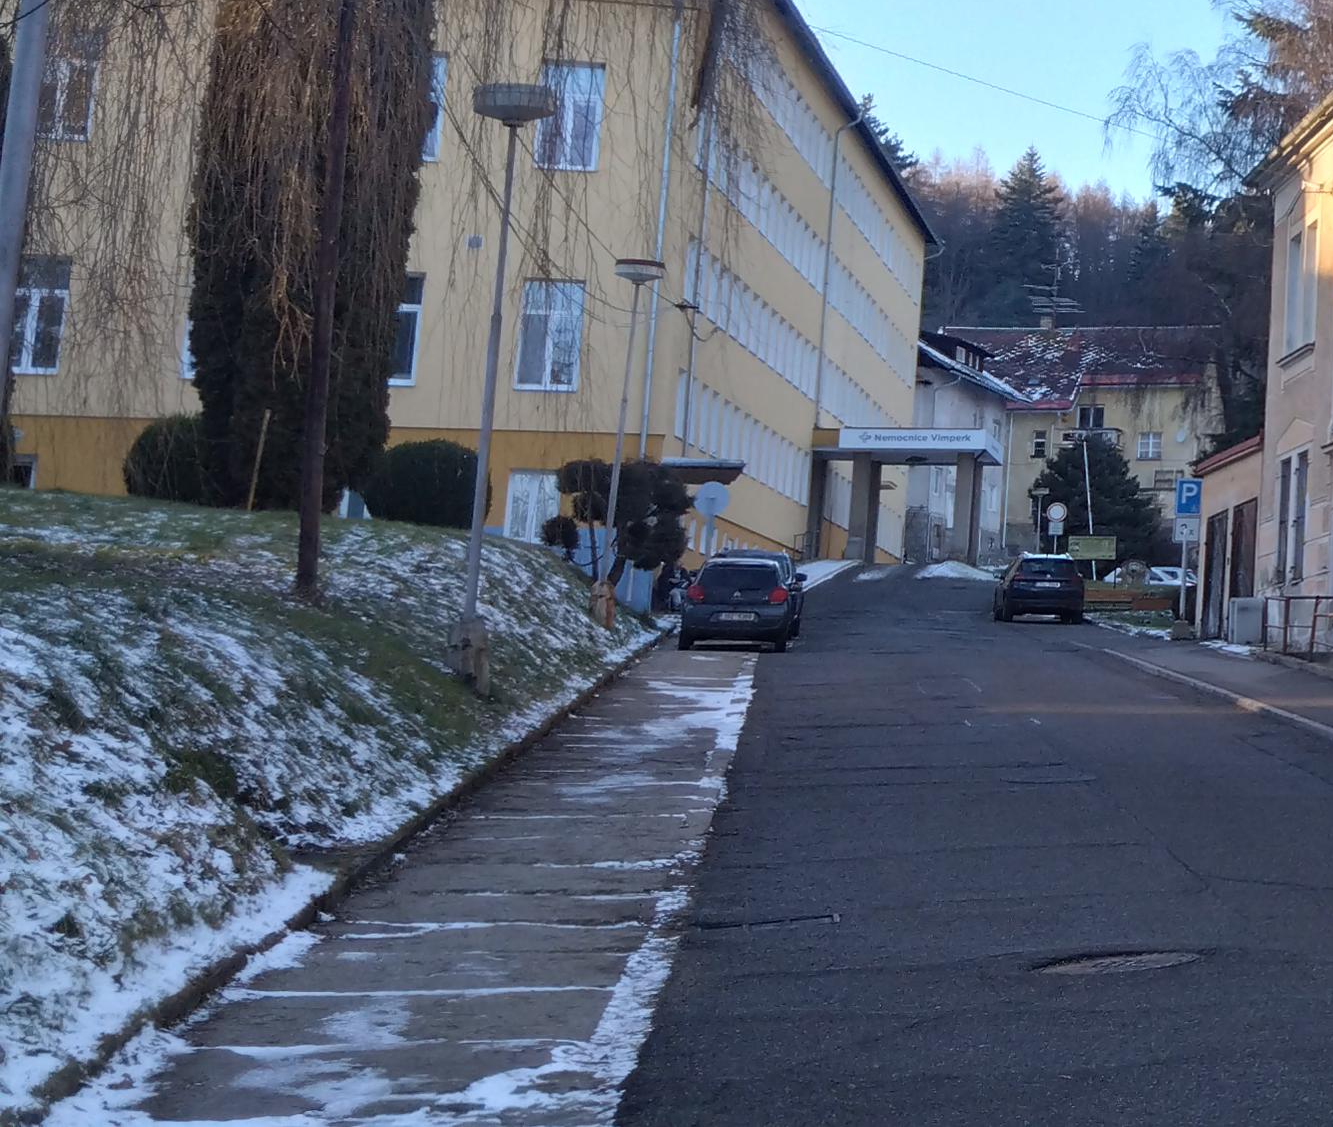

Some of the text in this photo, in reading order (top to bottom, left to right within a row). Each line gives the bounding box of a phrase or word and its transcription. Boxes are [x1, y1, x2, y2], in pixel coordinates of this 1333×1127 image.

[874, 434, 971, 443] Nemocnice Vimperk
[1181, 483, 1198, 504] P
